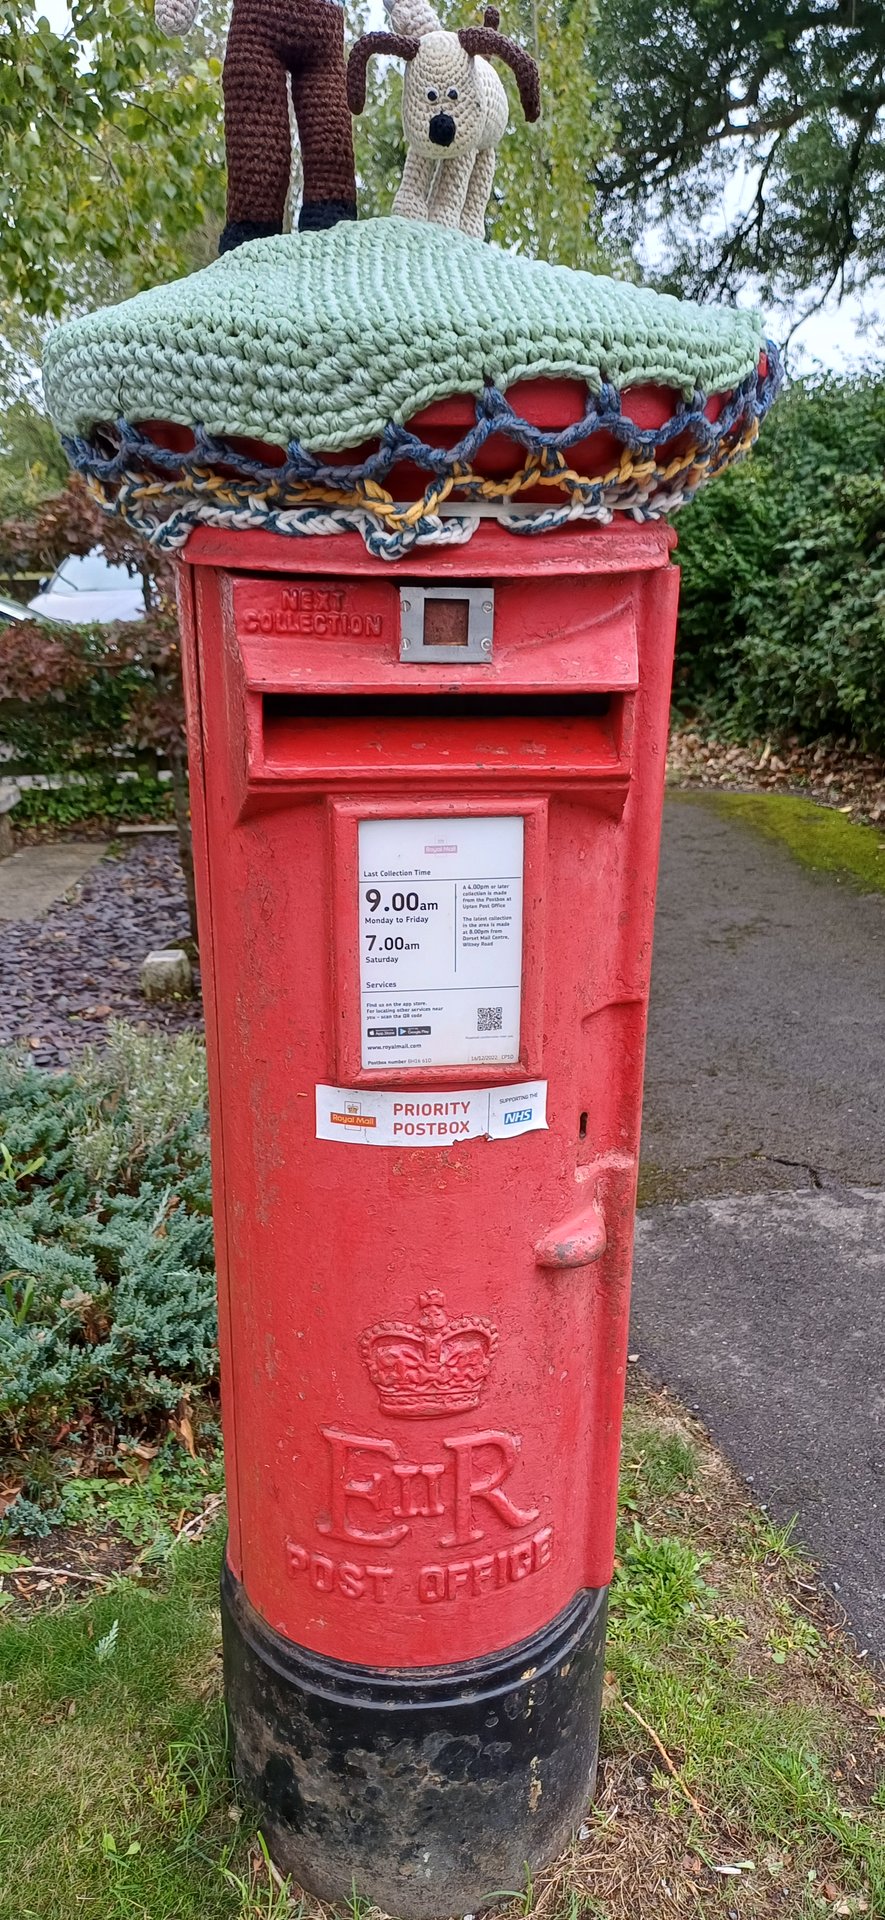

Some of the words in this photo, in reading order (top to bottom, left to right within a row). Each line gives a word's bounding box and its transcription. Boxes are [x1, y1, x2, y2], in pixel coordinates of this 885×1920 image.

[281, 588, 346, 612] NEXT
[243, 609, 383, 637] COLLECTION
[365, 888, 438, 912] 9.00am
[364, 917, 394, 925] Monday
[365, 934, 420, 951] 7.00am
[499, 1094, 529, 1104] SUPPORTING
[393, 1101, 471, 1116] PRIORITY
[332, 1114, 355, 1124] Royal
[356, 1116, 374, 1126] Mail
[505, 1109, 532, 1124] NHS
[393, 1121, 470, 1136] POSTBOX
[285, 1539, 394, 1604] POST
[418, 1524, 554, 1605] OFFICE
